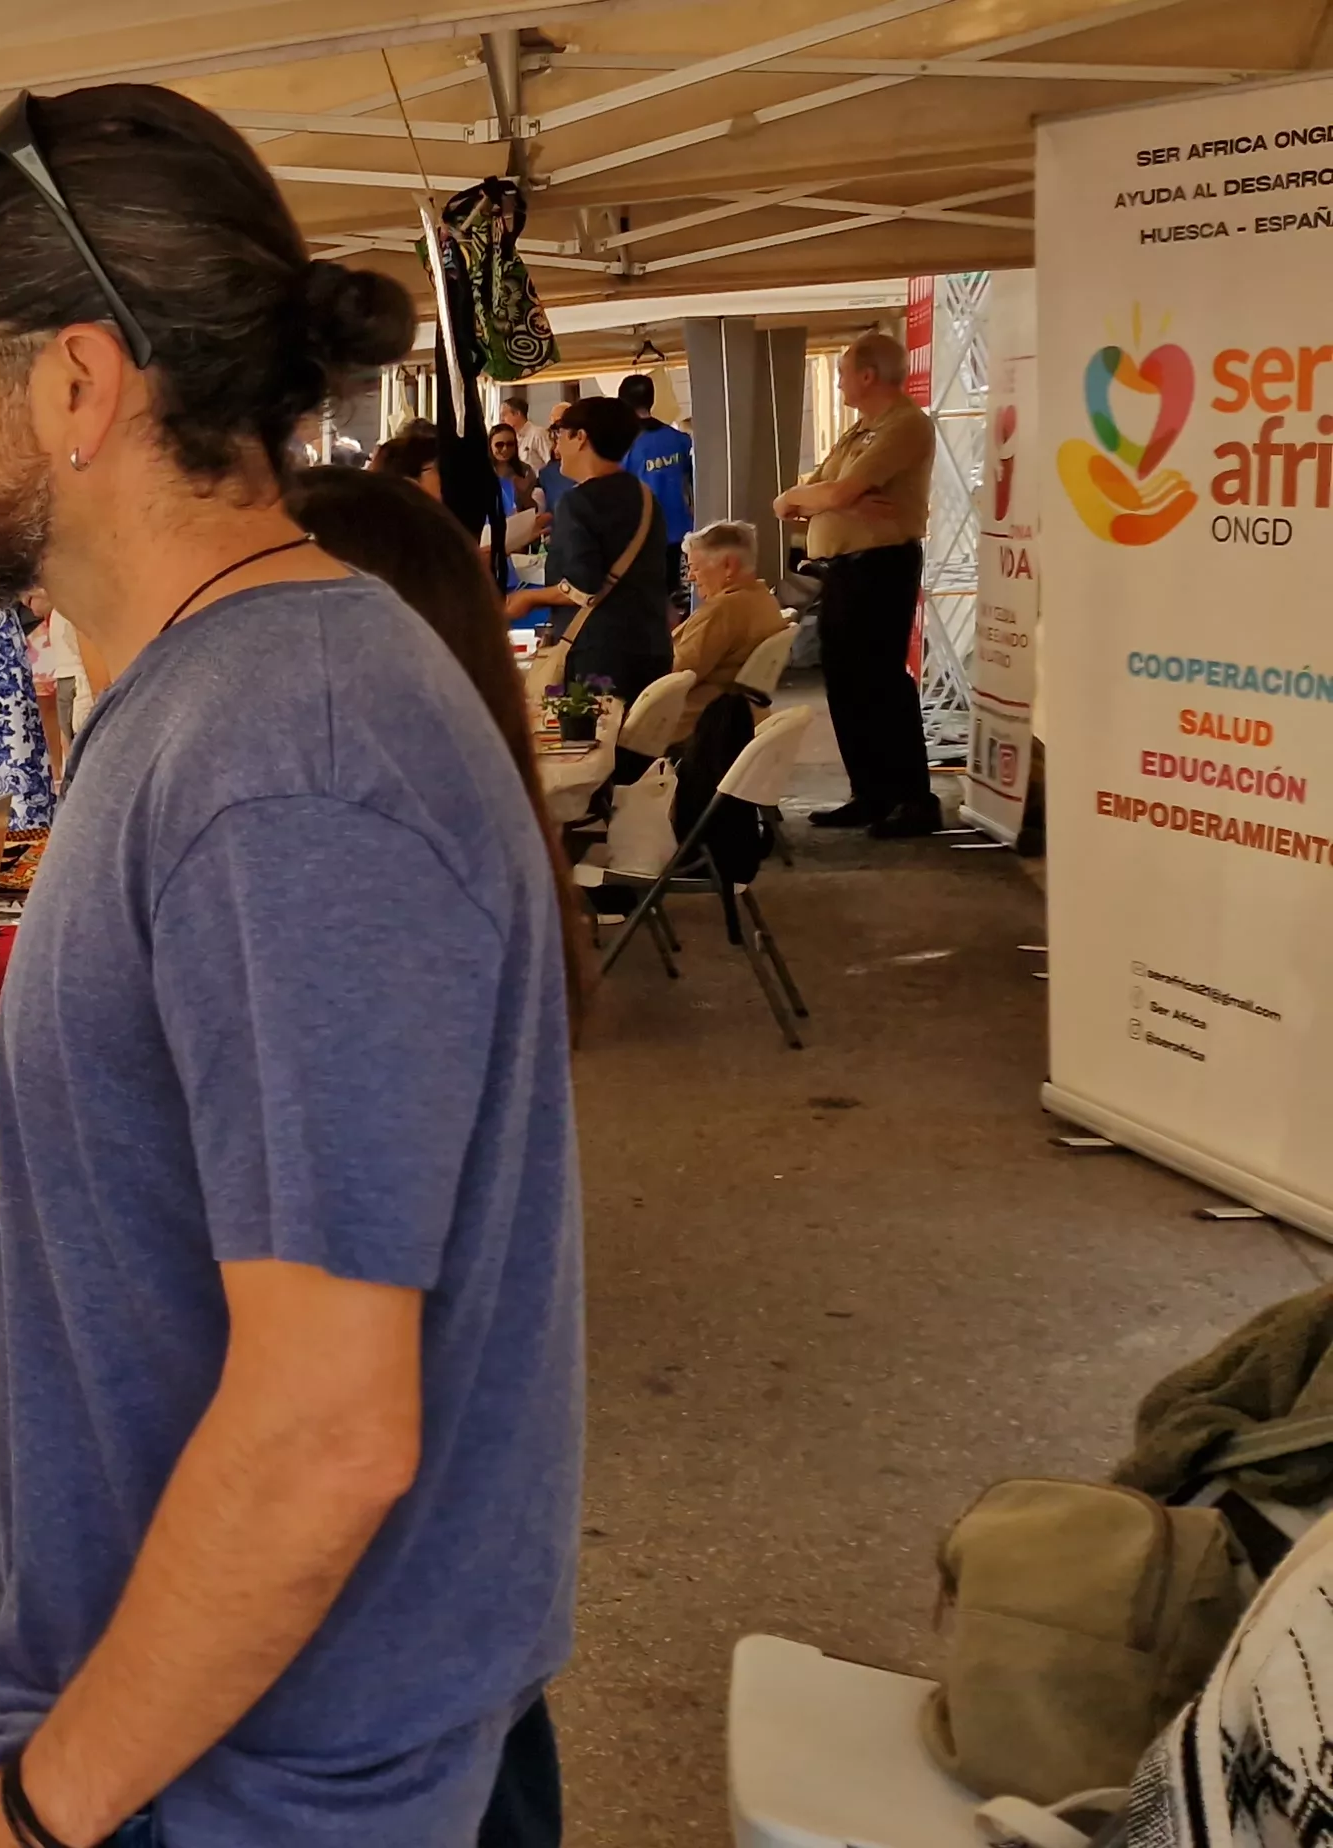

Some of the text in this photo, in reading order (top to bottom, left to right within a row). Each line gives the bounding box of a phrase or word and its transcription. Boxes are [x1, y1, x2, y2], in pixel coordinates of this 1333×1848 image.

[1136, 146, 1181, 167] SER
[1186, 134, 1268, 161] AFRICA
[1114, 185, 1187, 209] AYUDA
[1193, 182, 1218, 200] AL
[1140, 221, 1230, 245] HUESCA
[1254, 206, 1333, 234] ESPAÑ
[1210, 344, 1333, 414] ser
[1211, 515, 1293, 546] ONGD
[1128, 650, 1333, 704] COOPERACIÓN
[1179, 708, 1275, 748] SALUD
[1140, 750, 1308, 805] EDUCACIÓN
[1149, 1000, 1208, 1030] Ser Africa
